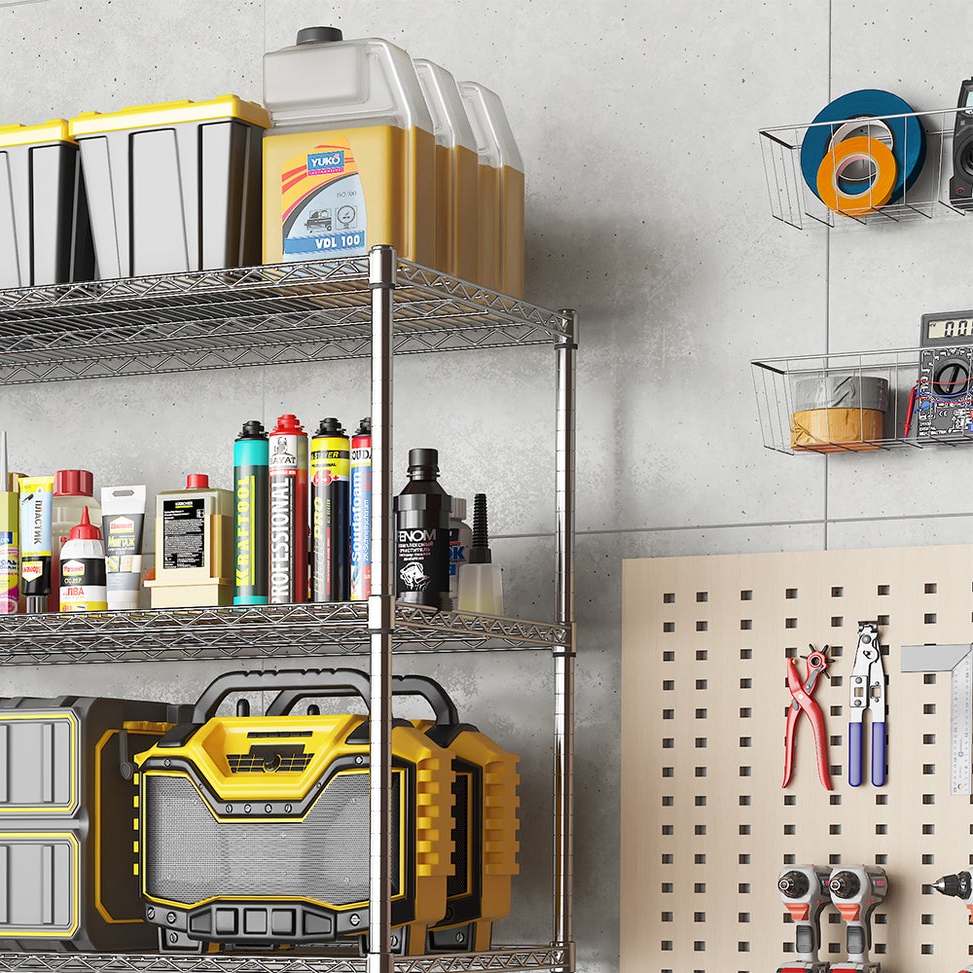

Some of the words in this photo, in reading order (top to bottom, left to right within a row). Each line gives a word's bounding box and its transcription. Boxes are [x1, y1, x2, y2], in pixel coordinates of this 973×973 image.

[311, 154, 340, 167] YUKO
[315, 238, 337, 249] VDL
[341, 235, 360, 246] 100
[944, 320, 973, 338] 00
[34, 500, 43, 545] ПЛАСТИК
[353, 472, 362, 562] Soudafoam
[236, 475, 250, 587] KRAFTOOL
[399, 529, 437, 542] ENOM
[68, 588, 84, 596] ПВА
